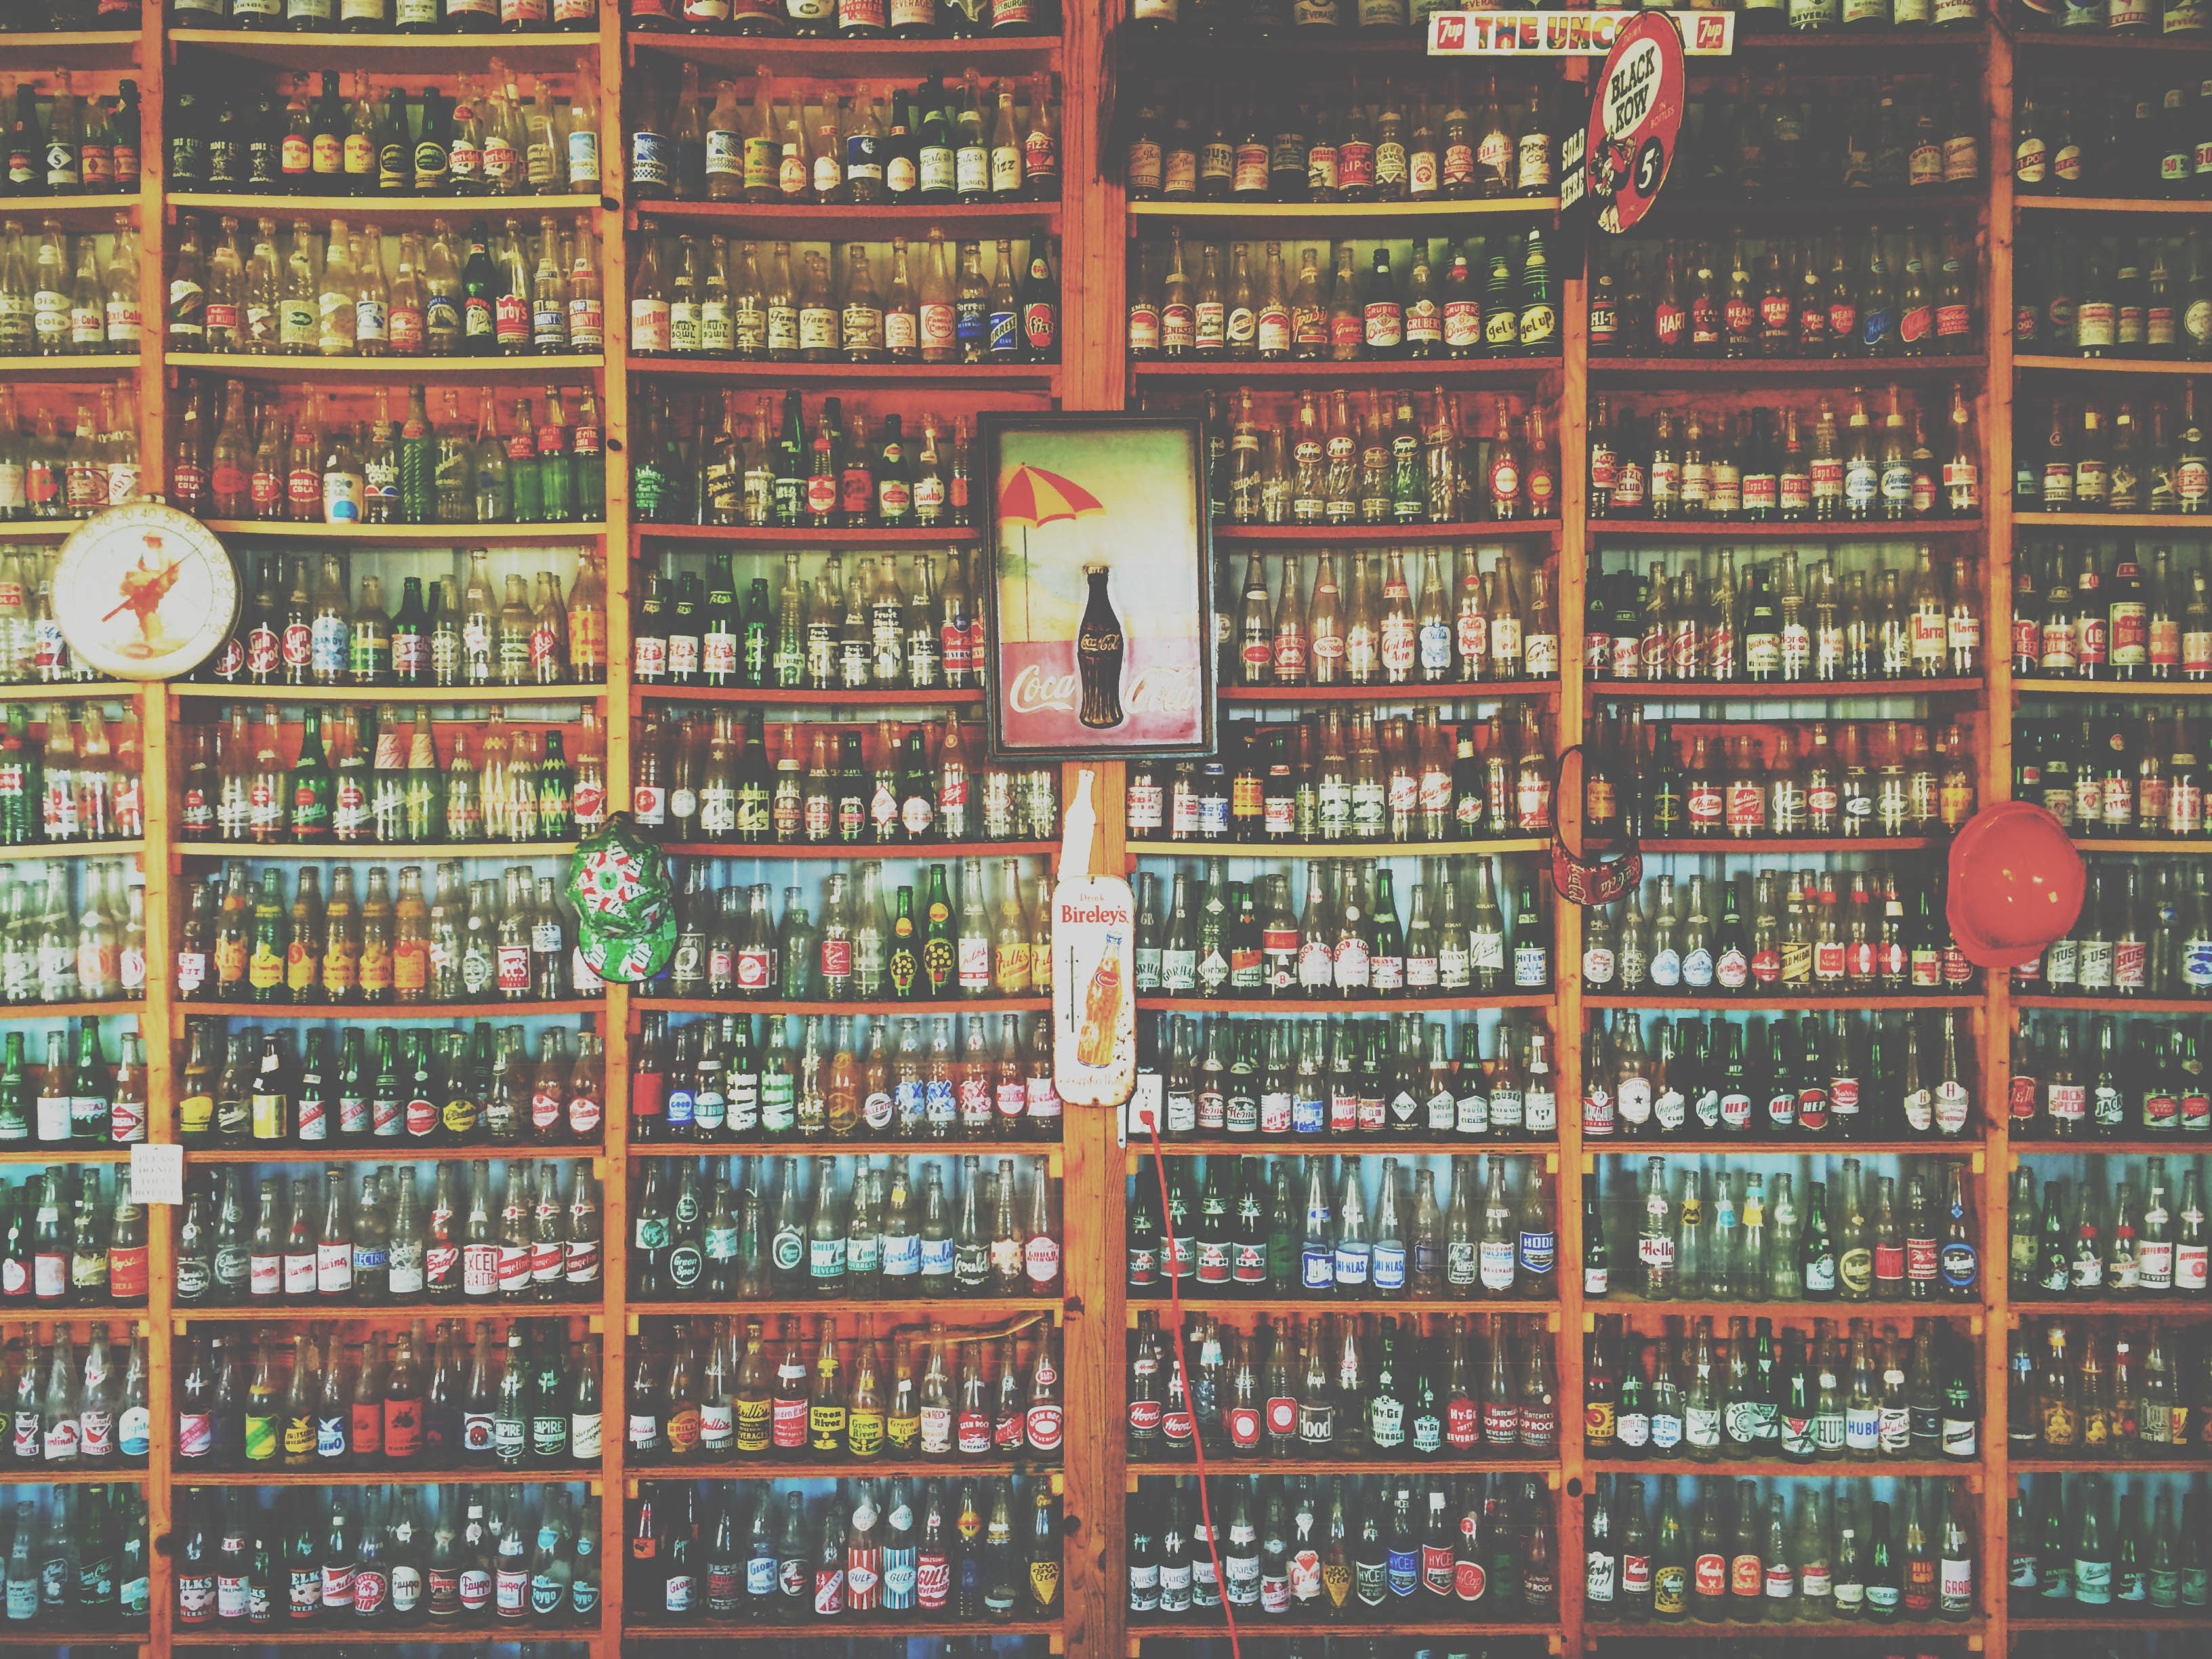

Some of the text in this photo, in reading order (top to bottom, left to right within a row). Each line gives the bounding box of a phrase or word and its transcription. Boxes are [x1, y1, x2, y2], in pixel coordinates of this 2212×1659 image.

[1439, 19, 1462, 44] 7up
[1475, 17, 1538, 49] THE
[1699, 19, 1721, 41] 7up
[1612, 47, 1655, 105] BLACK
[1614, 85, 1649, 134] KOW
[1650, 106, 1675, 129] BOTTLES
[1563, 128, 1584, 171] SOLD
[54, 154, 62, 165] S
[1561, 167, 1584, 210] HERE
[1031, 318, 1052, 335] fizz
[1538, 312, 1552, 328] up
[1659, 312, 1687, 335] HART
[140, 506, 157, 520] 40
[164, 510, 180, 524] 50
[1010, 663, 1075, 714] Coca
[1061, 905, 1128, 926] Bireley's
[1298, 945, 1314, 963] GOOD
[1333, 941, 1351, 961] GOOD
[1946, 1083, 1954, 1097] H
[464, 1250, 496, 1273] EXCEL
[954, 1252, 989, 1273] Gould
[851, 1420, 879, 1429] Green
[1164, 1416, 1193, 1432] Hood
[853, 1429, 876, 1438] River
[1389, 1555, 1416, 1570] HYCEE
[180, 1578, 212, 1589] ELKS
[462, 1575, 491, 1595] Faygo
[851, 1572, 873, 1583] GULF
[890, 1572, 914, 1582] GULF
[918, 1570, 946, 1586] GULF
